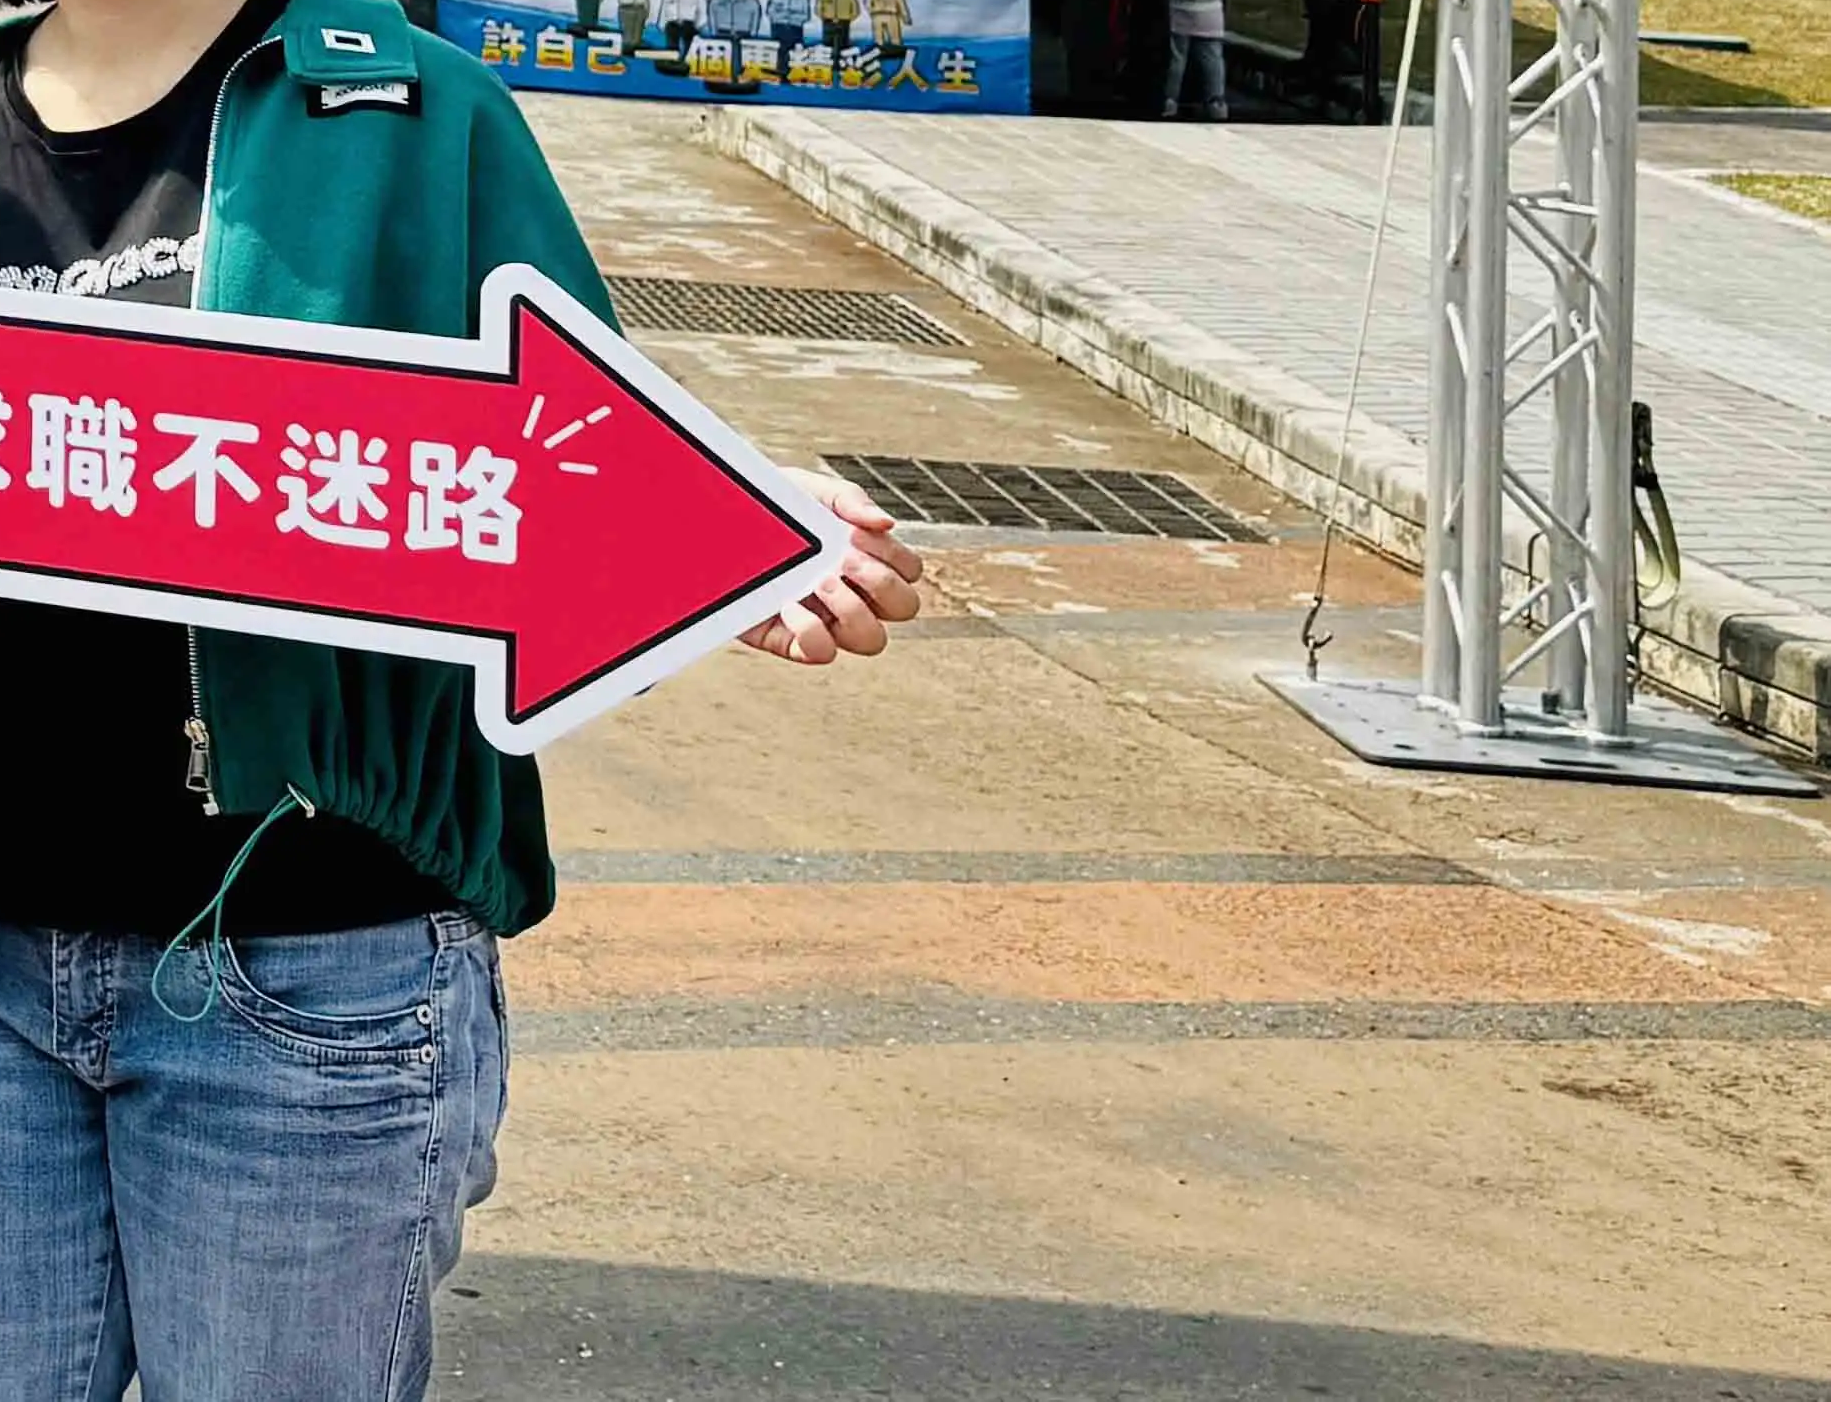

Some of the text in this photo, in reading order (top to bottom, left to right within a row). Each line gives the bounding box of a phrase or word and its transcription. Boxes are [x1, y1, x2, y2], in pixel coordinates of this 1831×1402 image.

[481, 17, 981, 96] 許自己一個更精彩人生
